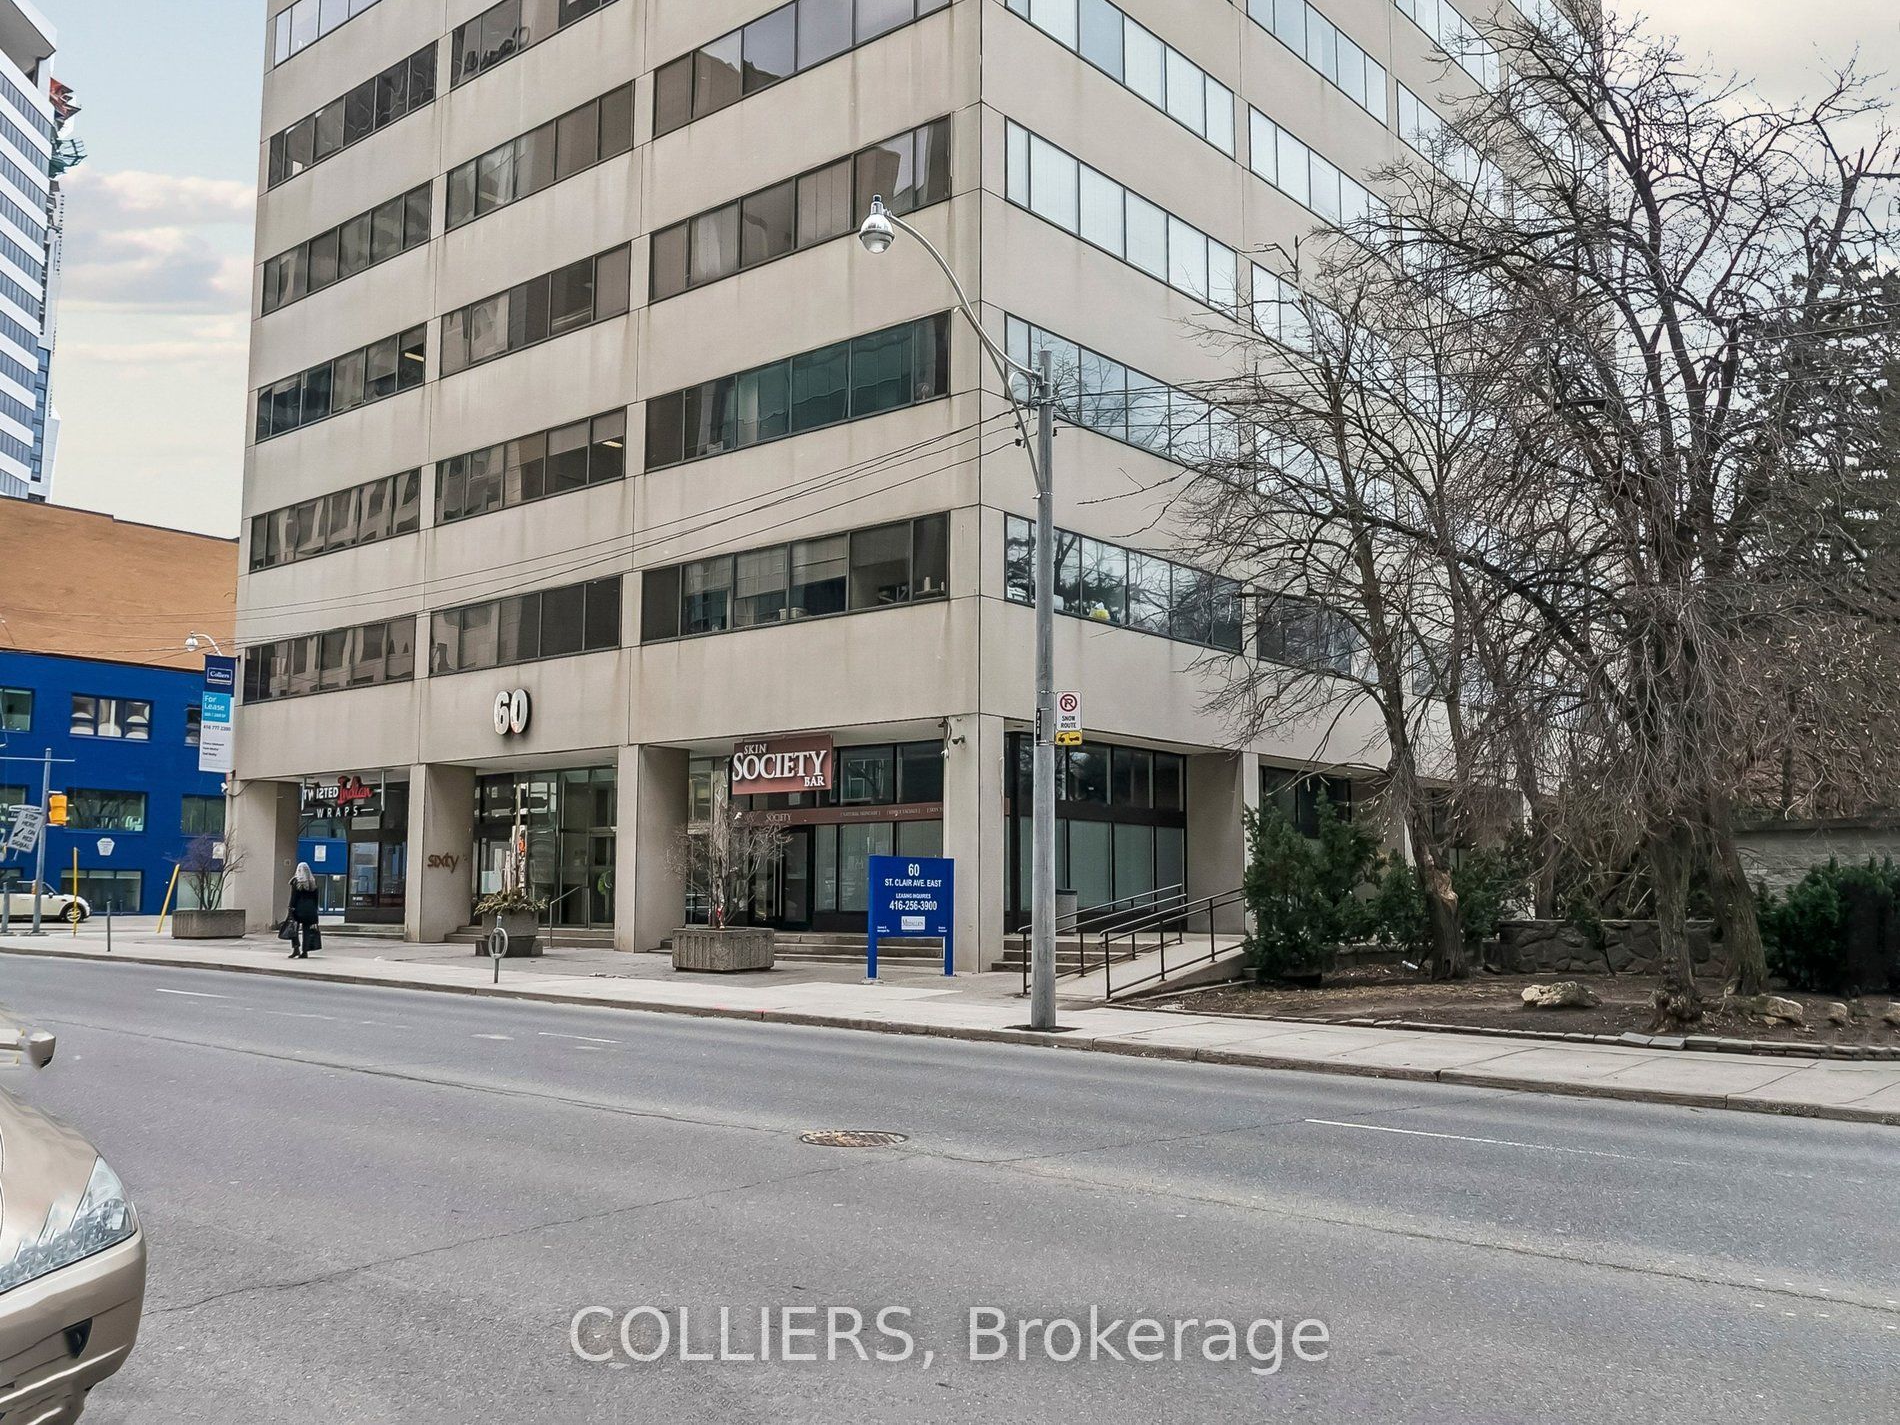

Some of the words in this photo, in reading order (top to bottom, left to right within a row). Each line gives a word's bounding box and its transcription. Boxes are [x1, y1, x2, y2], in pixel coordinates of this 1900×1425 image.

[204, 695, 217, 703] For
[204, 702, 225, 710] Lease
[494, 688, 528, 735] 60
[743, 743, 768, 755] SKIN
[732, 750, 828, 781] SOCIETY
[804, 776, 825, 787] BAR
[316, 805, 359, 818] WRAPS
[11, 839, 31, 849] SIGNAL
[21, 835, 33, 843] RED
[427, 852, 459, 874] sixty
[908, 863, 920, 877] 60
[884, 878, 894, 887] ST.
[894, 878, 912, 887] CLAIR
[912, 879, 926, 887] AVE.
[926, 879, 942, 888] EAST
[889, 900, 938, 911] 416-256-3900
